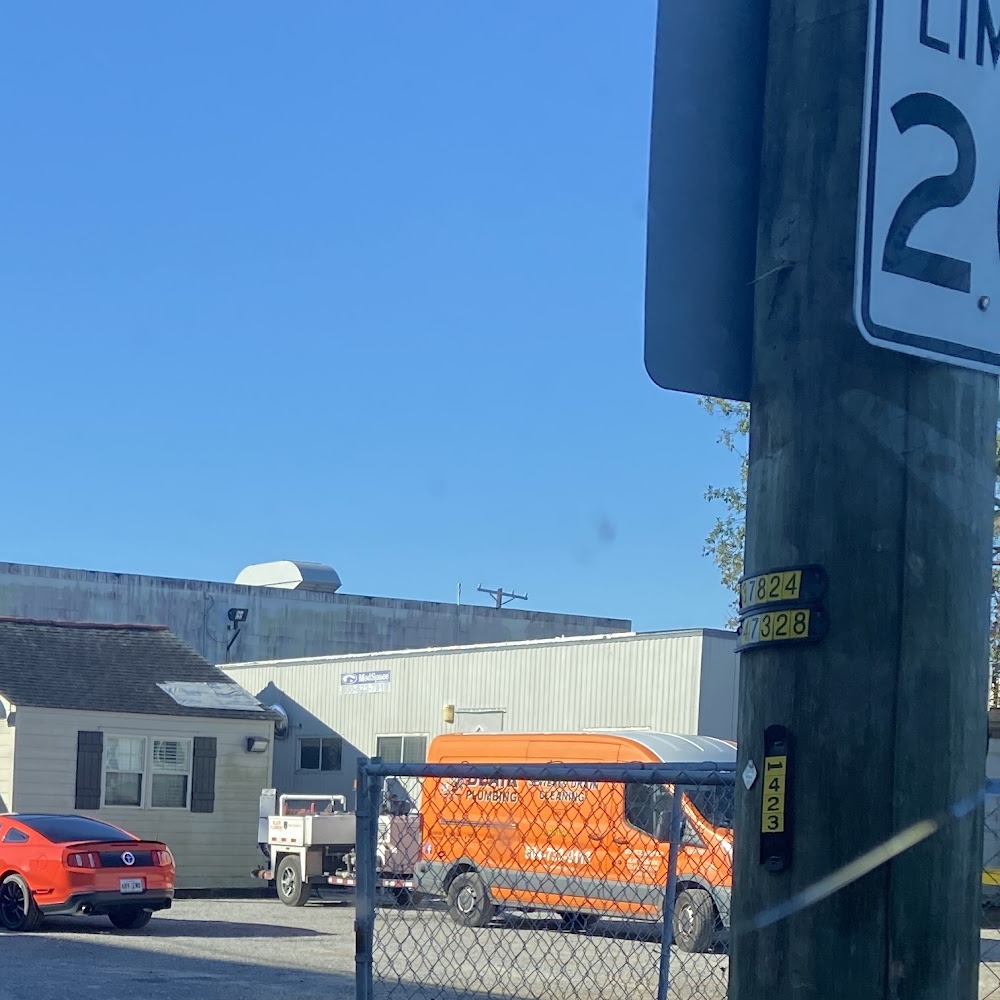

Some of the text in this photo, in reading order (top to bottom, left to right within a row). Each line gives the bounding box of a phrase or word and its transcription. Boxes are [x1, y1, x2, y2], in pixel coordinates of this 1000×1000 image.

[882, 92, 1000, 293] 2
[466, 789, 519, 803] PLUMBING
[540, 790, 585, 802] CLEANING
[767, 762, 783, 830] 1423
